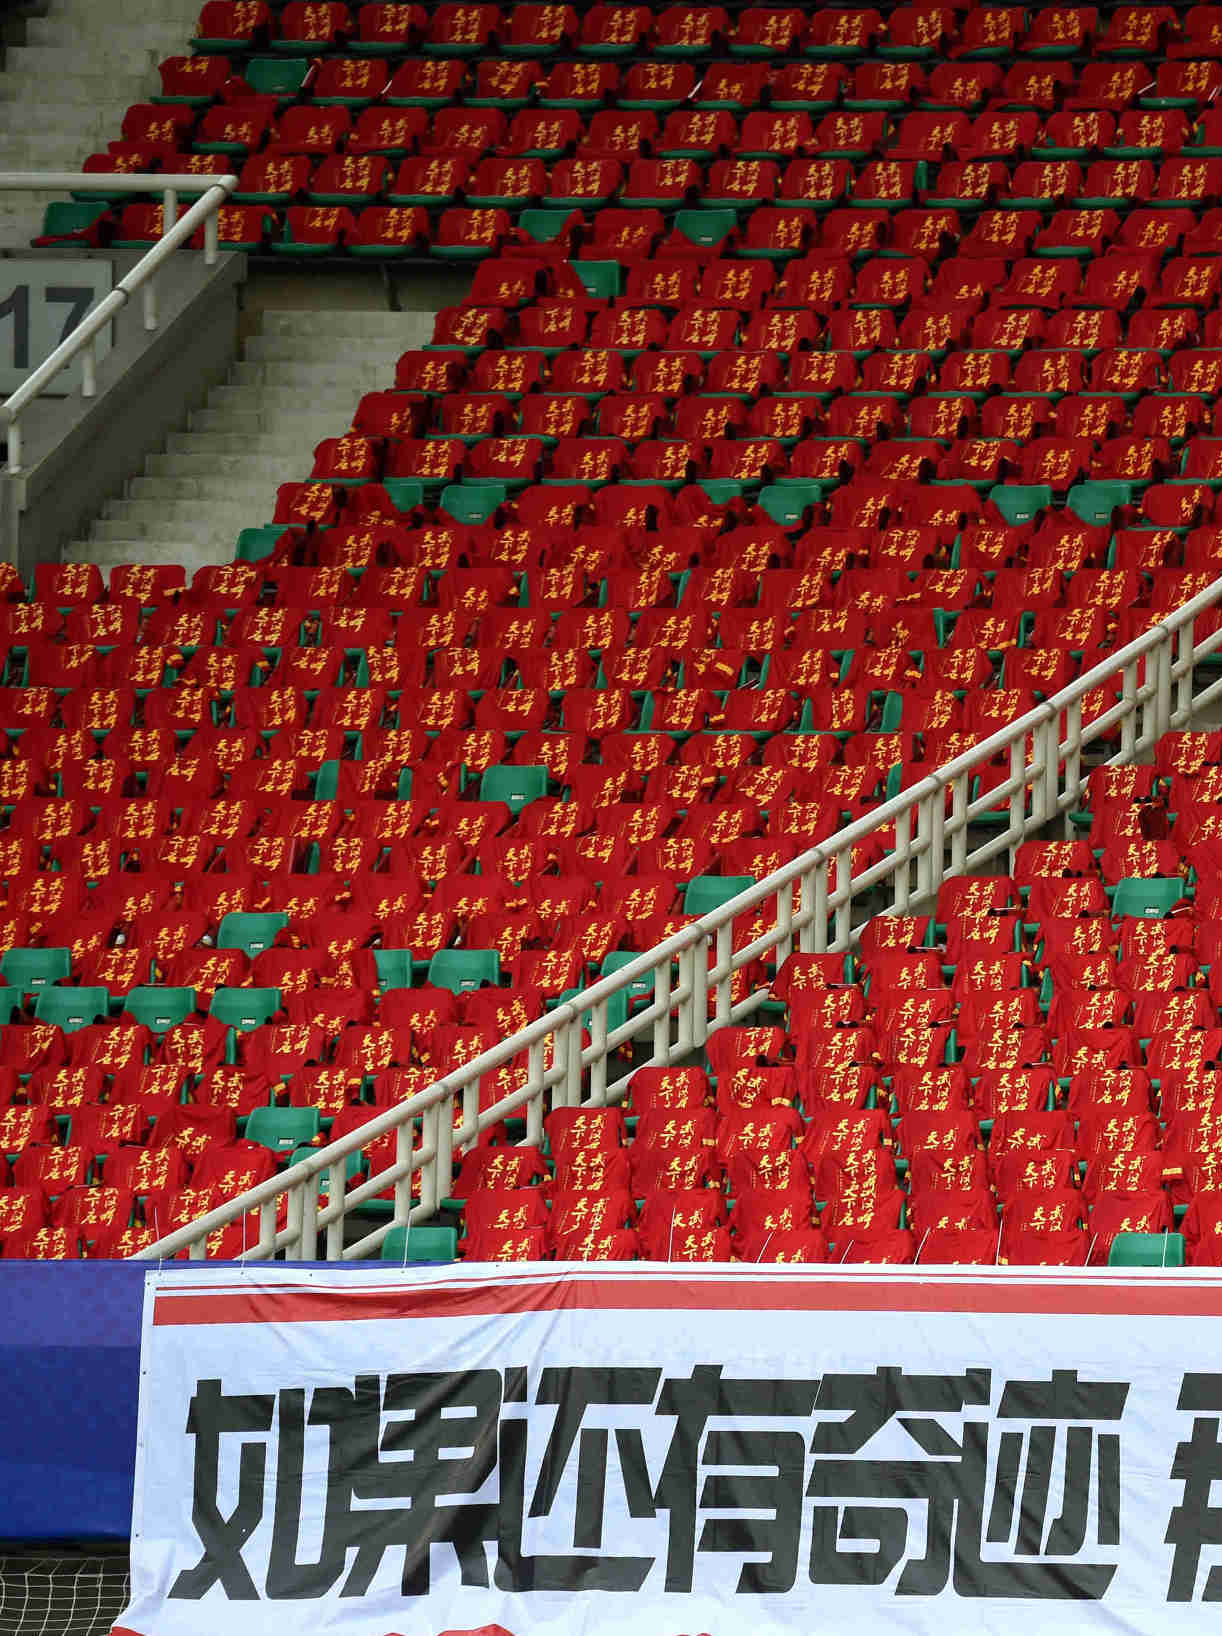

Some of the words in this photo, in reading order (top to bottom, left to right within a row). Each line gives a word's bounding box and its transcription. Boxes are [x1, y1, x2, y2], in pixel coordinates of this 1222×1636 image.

[167, 1364, 1131, 1600] 如果还有奇迹
